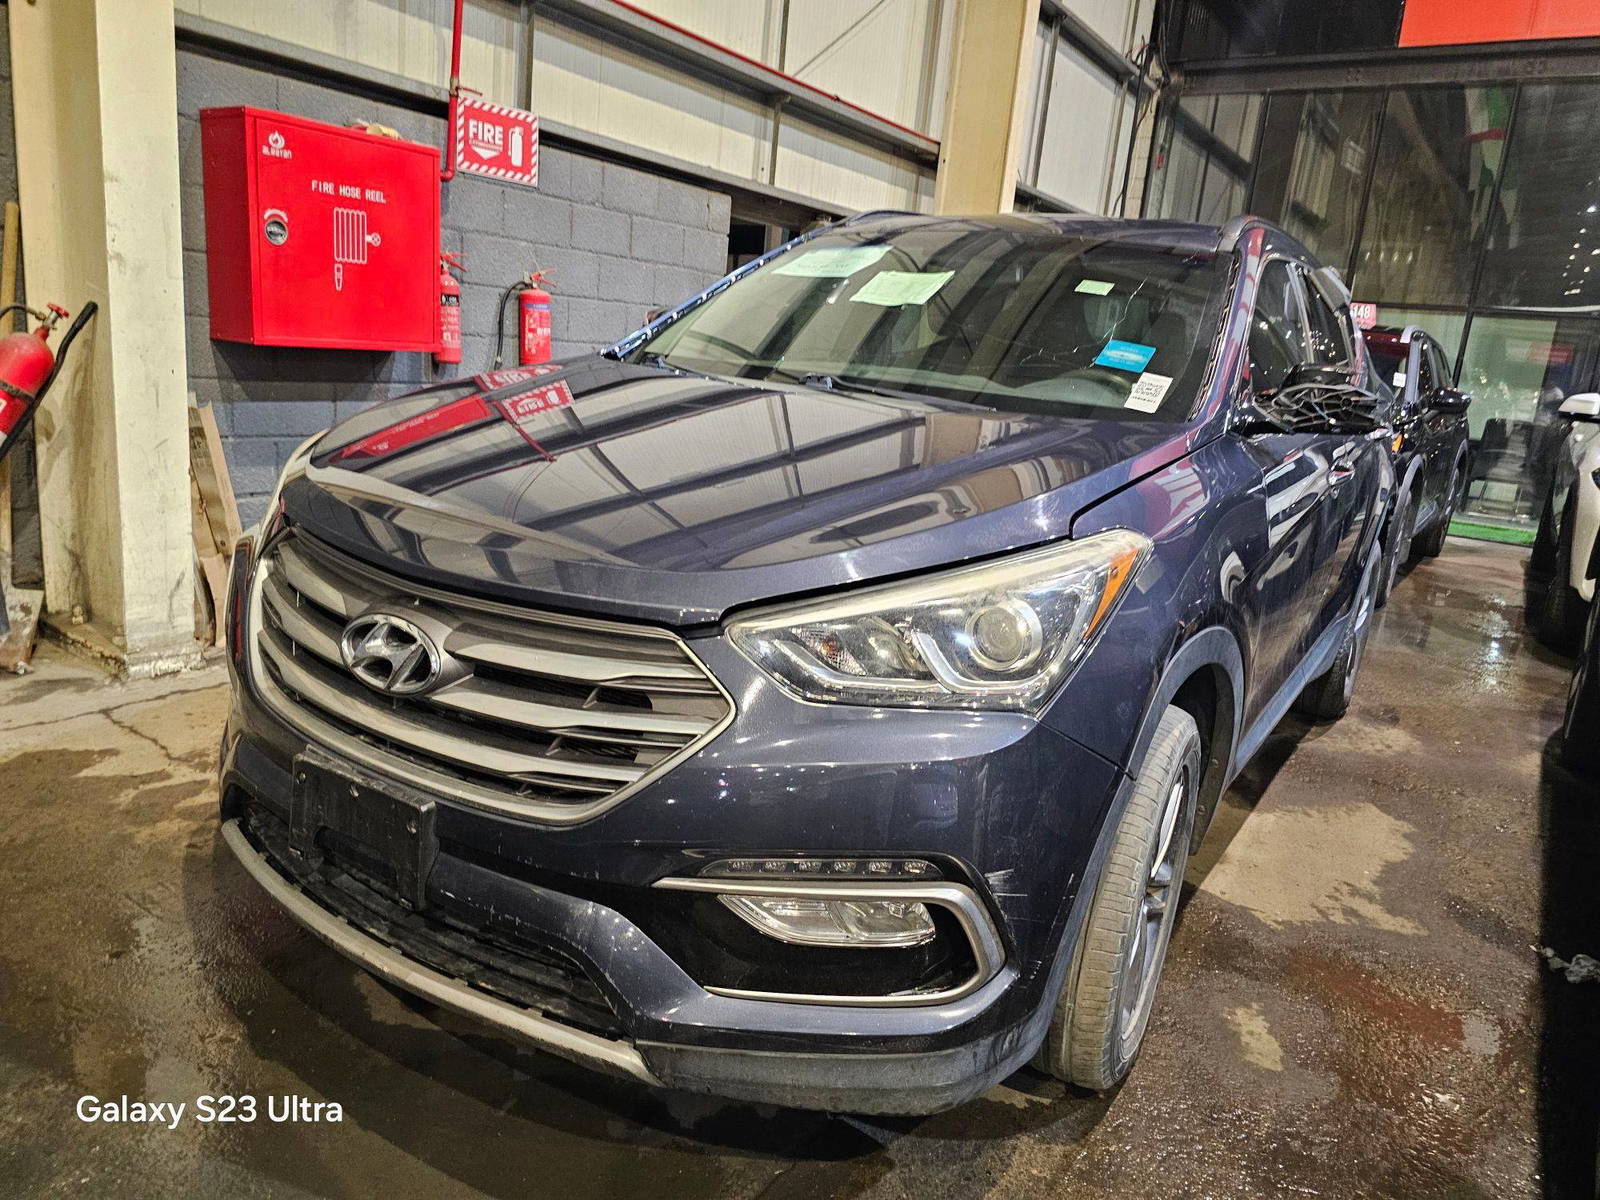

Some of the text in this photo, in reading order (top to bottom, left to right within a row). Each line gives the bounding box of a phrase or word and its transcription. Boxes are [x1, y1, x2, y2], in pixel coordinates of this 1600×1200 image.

[469, 118, 504, 145] FIRE
[311, 179, 387, 204] FIRE HOSE REEL
